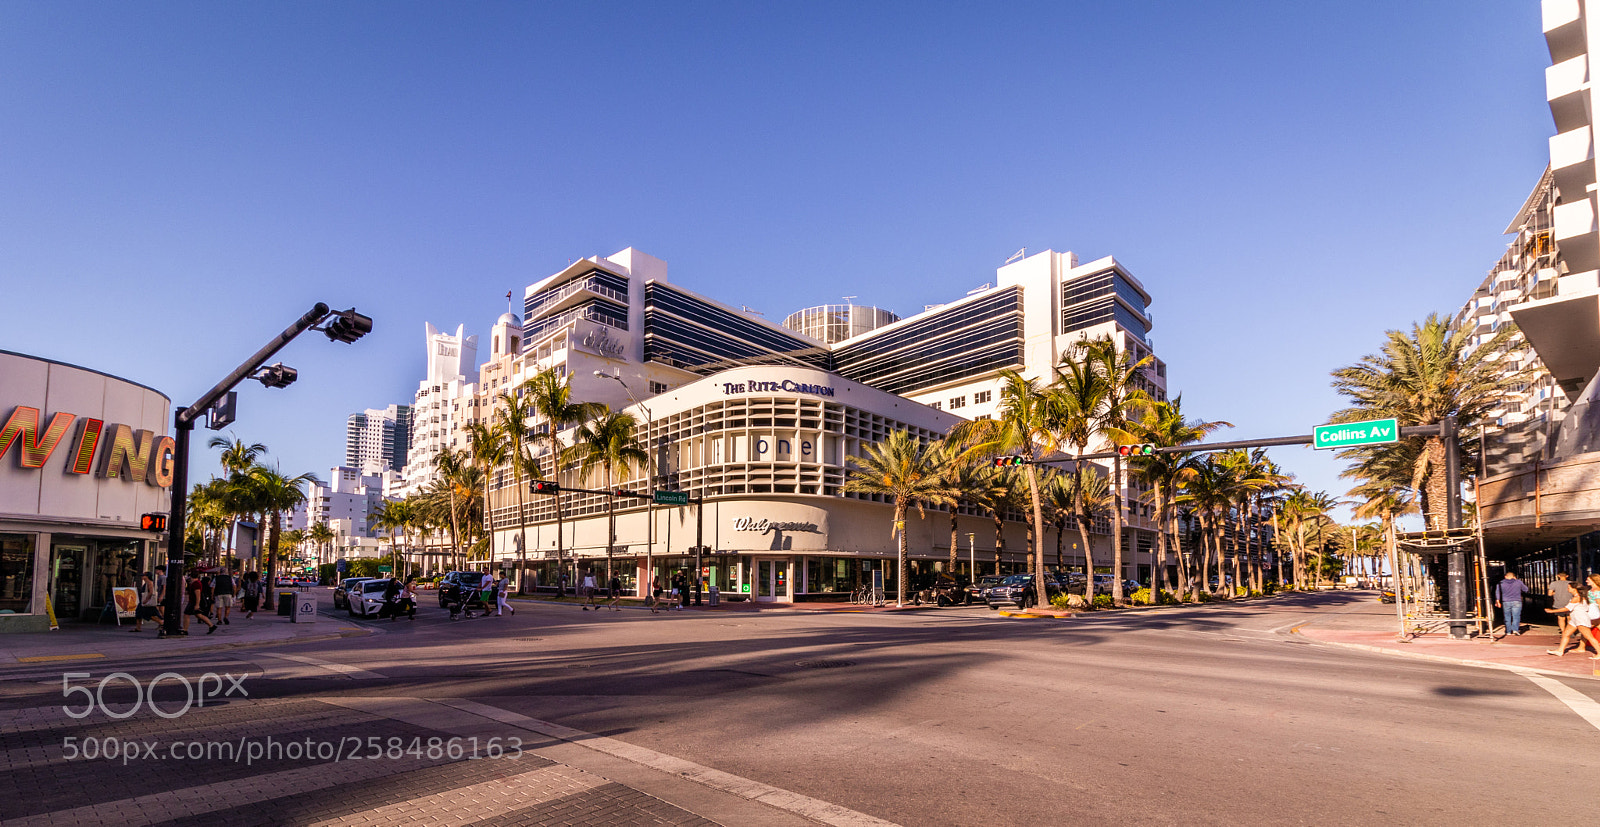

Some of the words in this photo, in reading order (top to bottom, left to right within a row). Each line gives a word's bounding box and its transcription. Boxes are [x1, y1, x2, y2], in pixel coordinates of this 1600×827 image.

[723, 382, 745, 395] THE
[747, 379, 835, 397] RITZ-CARLTON
[1320, 429, 1367, 442] Collins
[1369, 426, 1391, 438] Av
[756, 439, 812, 456] one
[155, 517, 165, 529] 11
